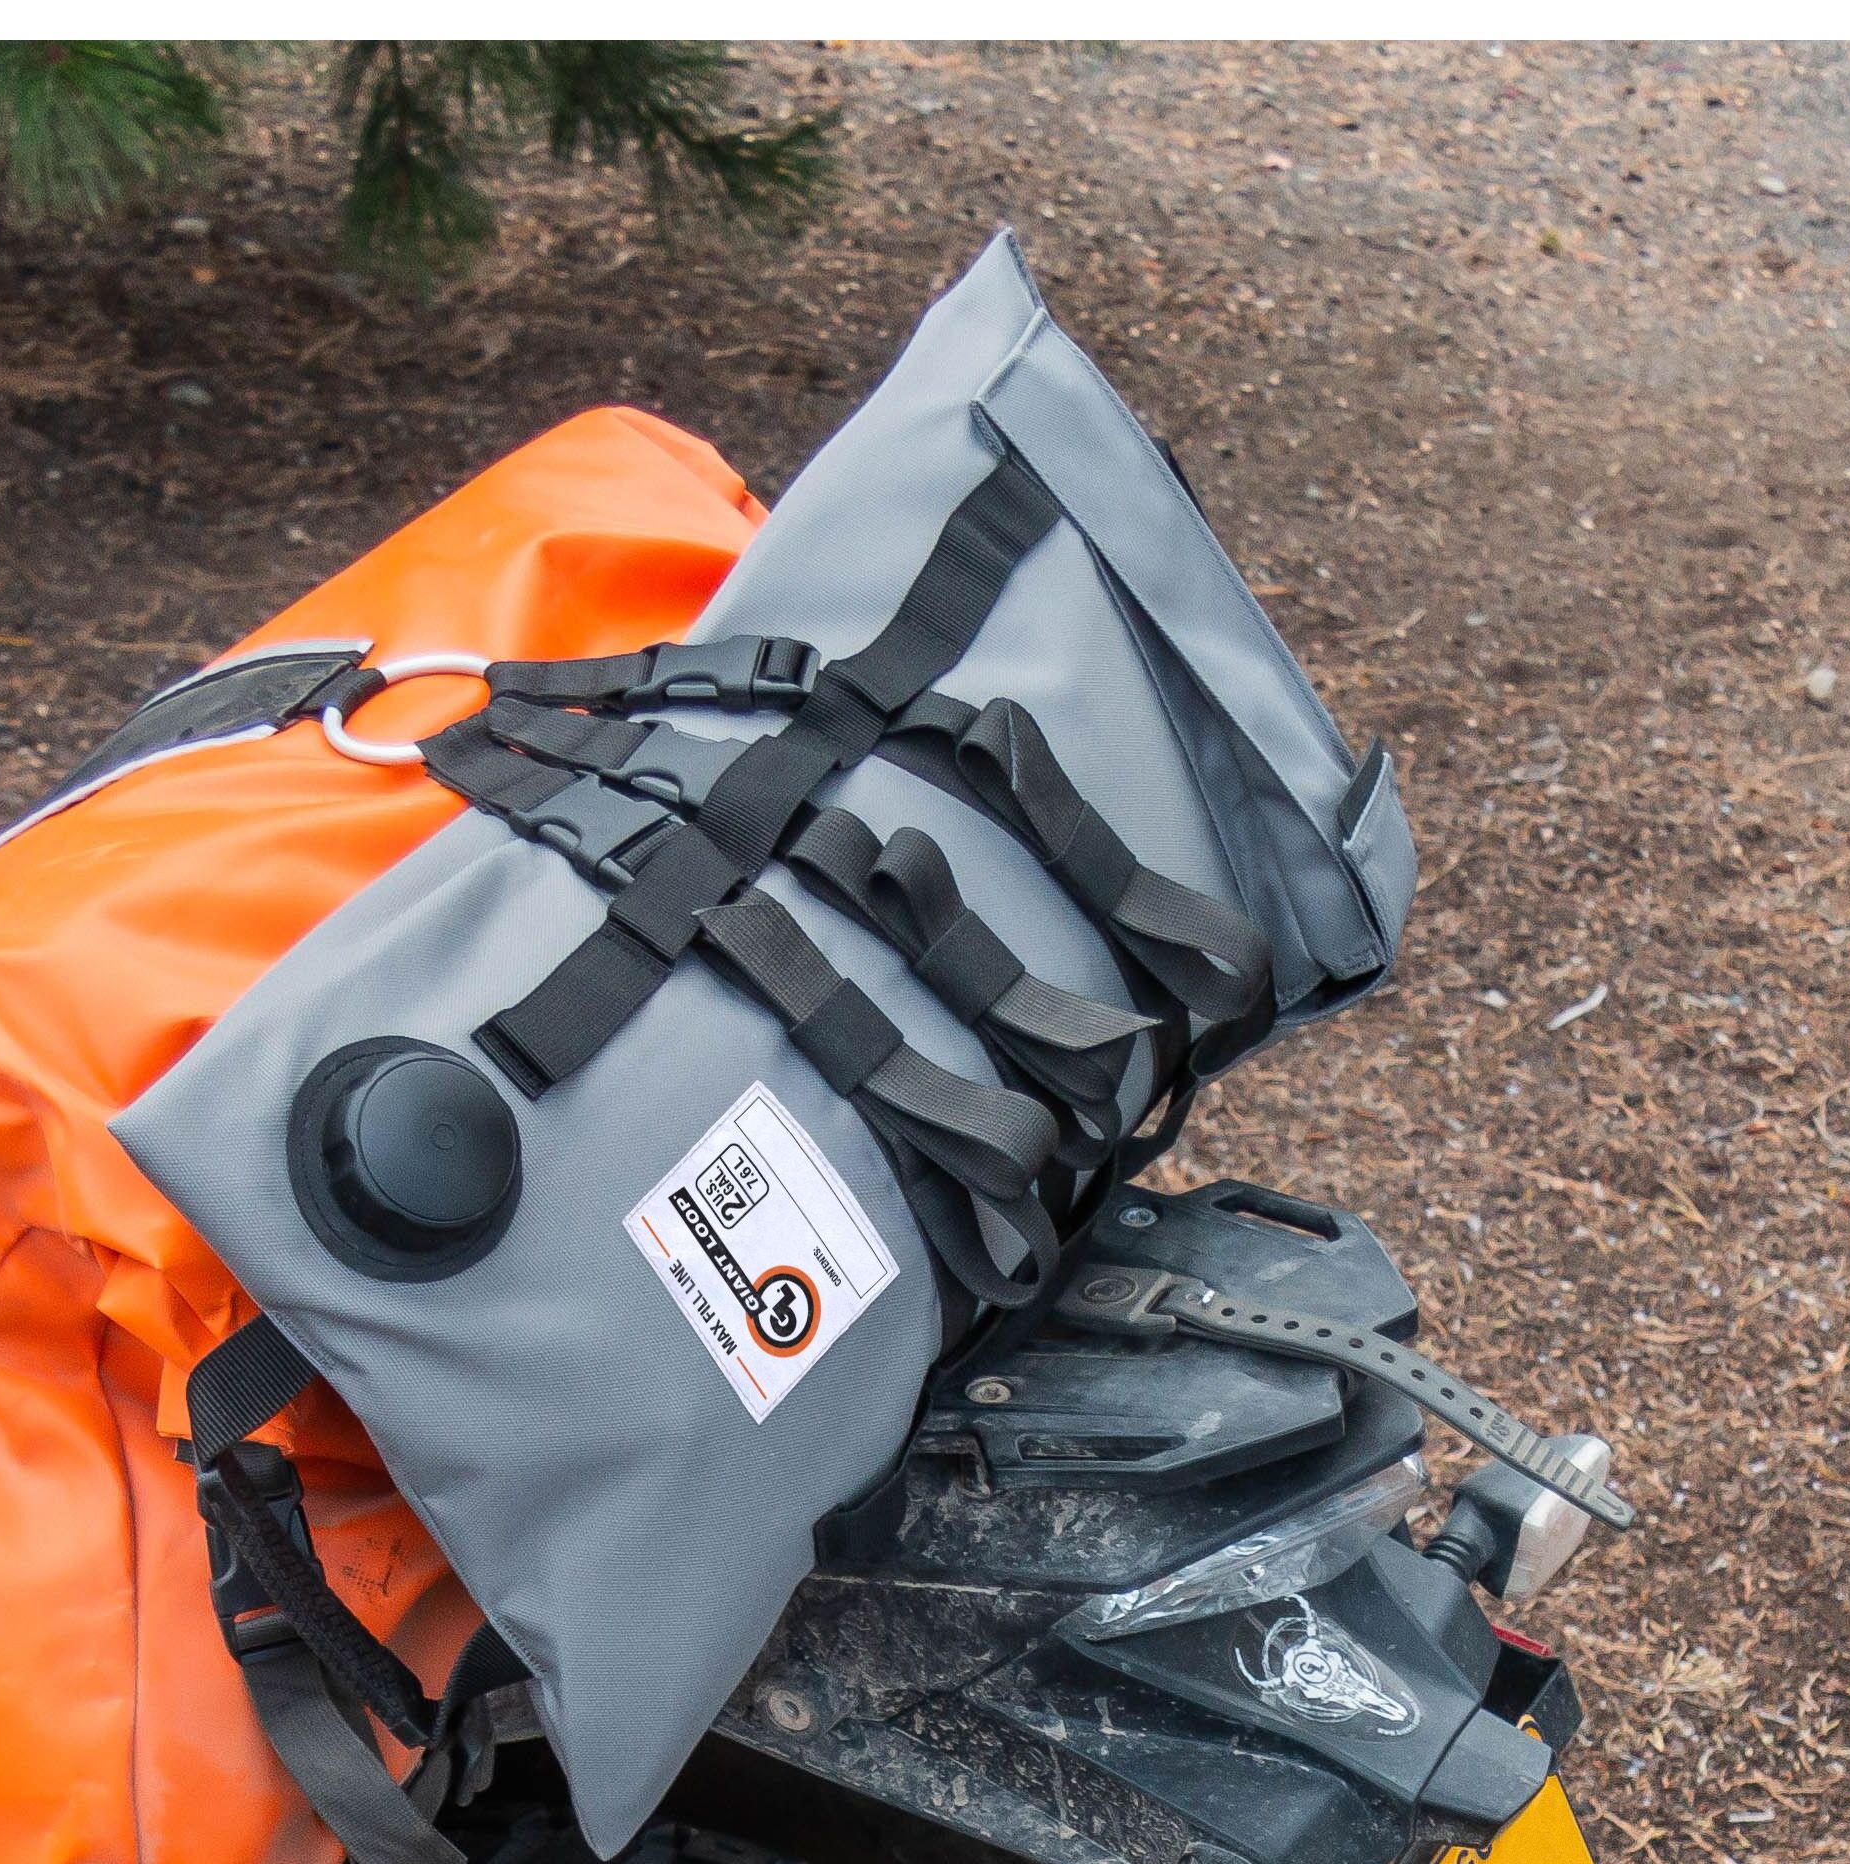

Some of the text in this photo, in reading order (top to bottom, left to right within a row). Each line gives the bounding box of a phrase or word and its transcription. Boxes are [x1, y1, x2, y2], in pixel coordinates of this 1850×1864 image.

[715, 1166, 734, 1195] GAL.
[740, 1167, 758, 1189] 7.6
[706, 1180, 724, 1206] U.S.
[718, 1192, 747, 1221] 2
[674, 1196, 760, 1311] GIANT LOOP
[814, 1247, 841, 1286] CONTENTS:
[669, 1259, 737, 1355] MAX FILL LINE
